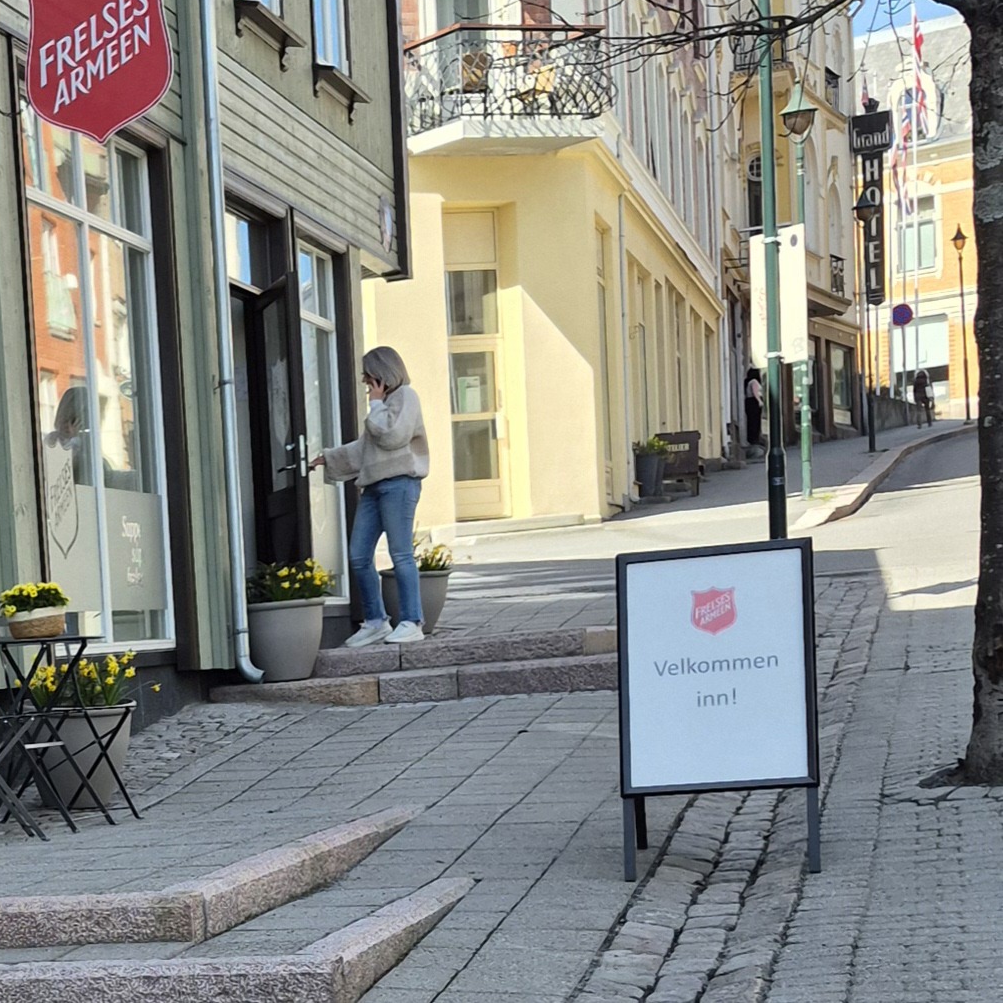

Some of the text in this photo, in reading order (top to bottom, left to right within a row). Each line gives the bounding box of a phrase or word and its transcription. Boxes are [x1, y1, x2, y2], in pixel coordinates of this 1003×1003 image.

[53, 16, 151, 115] ARMEEN
[853, 123, 890, 149] Grand
[864, 158, 882, 291] HOTEL
[654, 654, 779, 676] Velkommen
[696, 688, 737, 707] inn!
